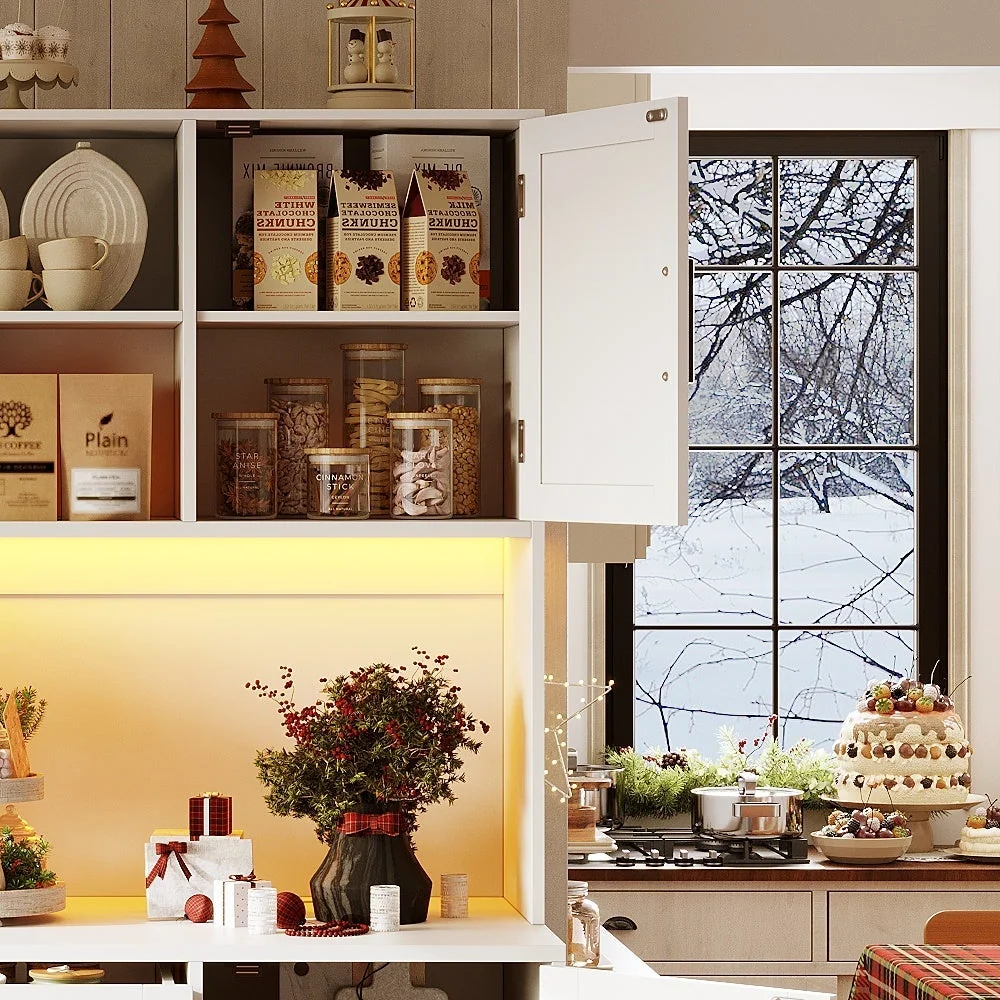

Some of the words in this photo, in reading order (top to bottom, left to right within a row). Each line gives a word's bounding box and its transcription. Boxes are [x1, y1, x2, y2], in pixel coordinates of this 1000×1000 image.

[85, 431, 129, 448] Plain
[235, 452, 259, 460] STAR
[232, 461, 261, 469] ANISE
[326, 483, 354, 491] STICK
